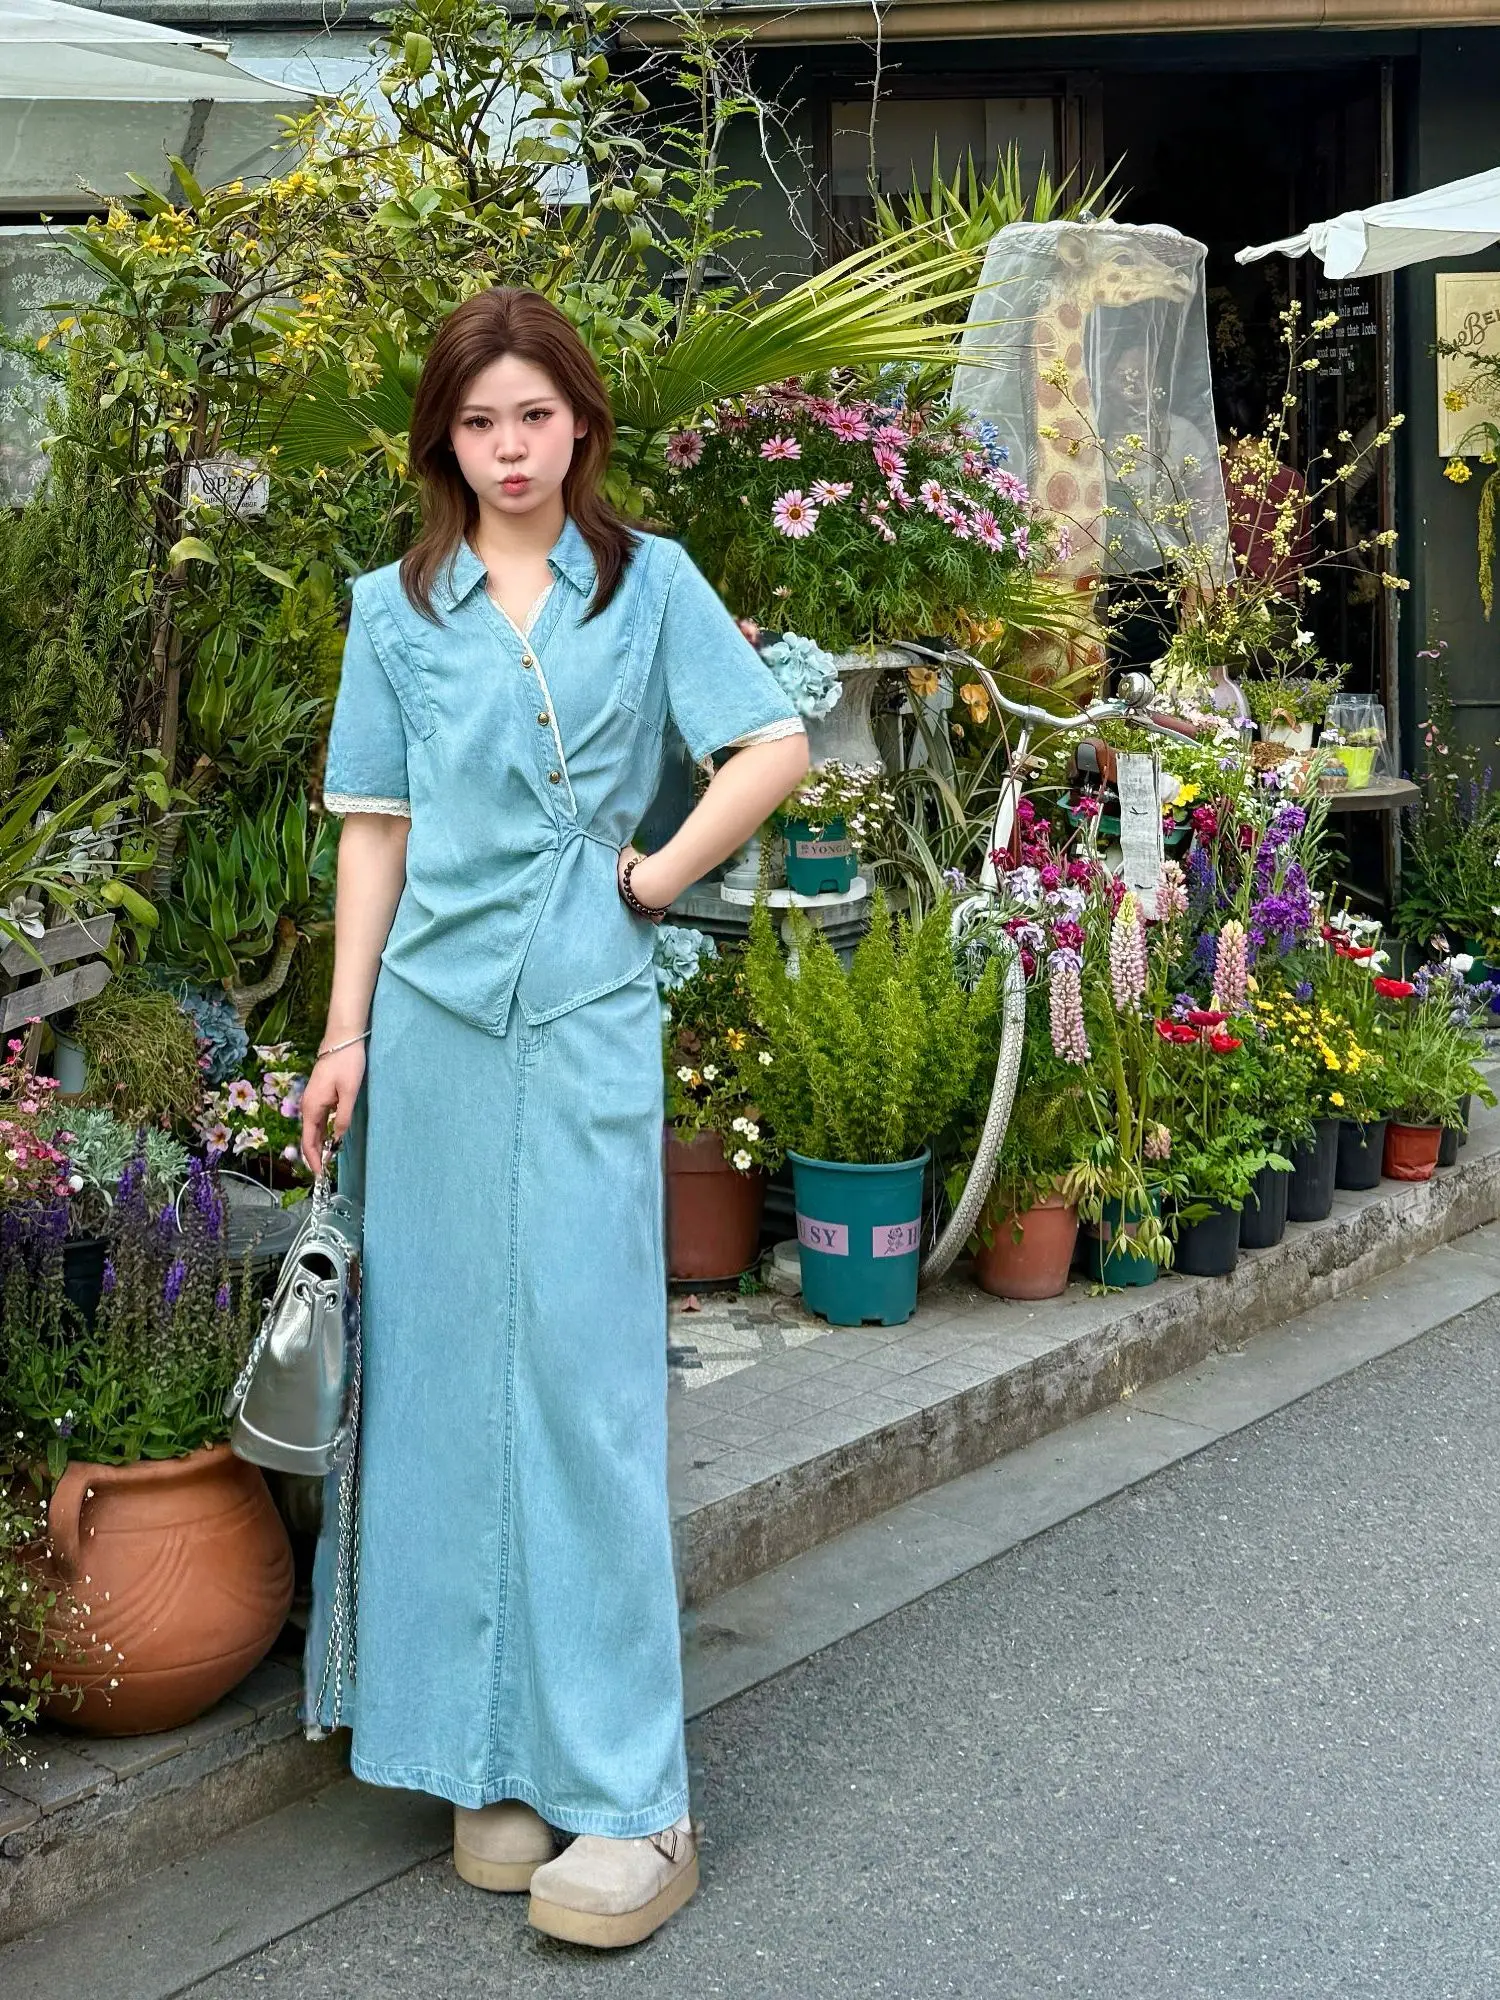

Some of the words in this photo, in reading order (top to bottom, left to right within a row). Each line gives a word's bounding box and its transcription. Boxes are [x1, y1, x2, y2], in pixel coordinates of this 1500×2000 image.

[1352, 302, 1369, 315] world
[1347, 323, 1360, 337] that
[1362, 322, 1377, 336] looks
